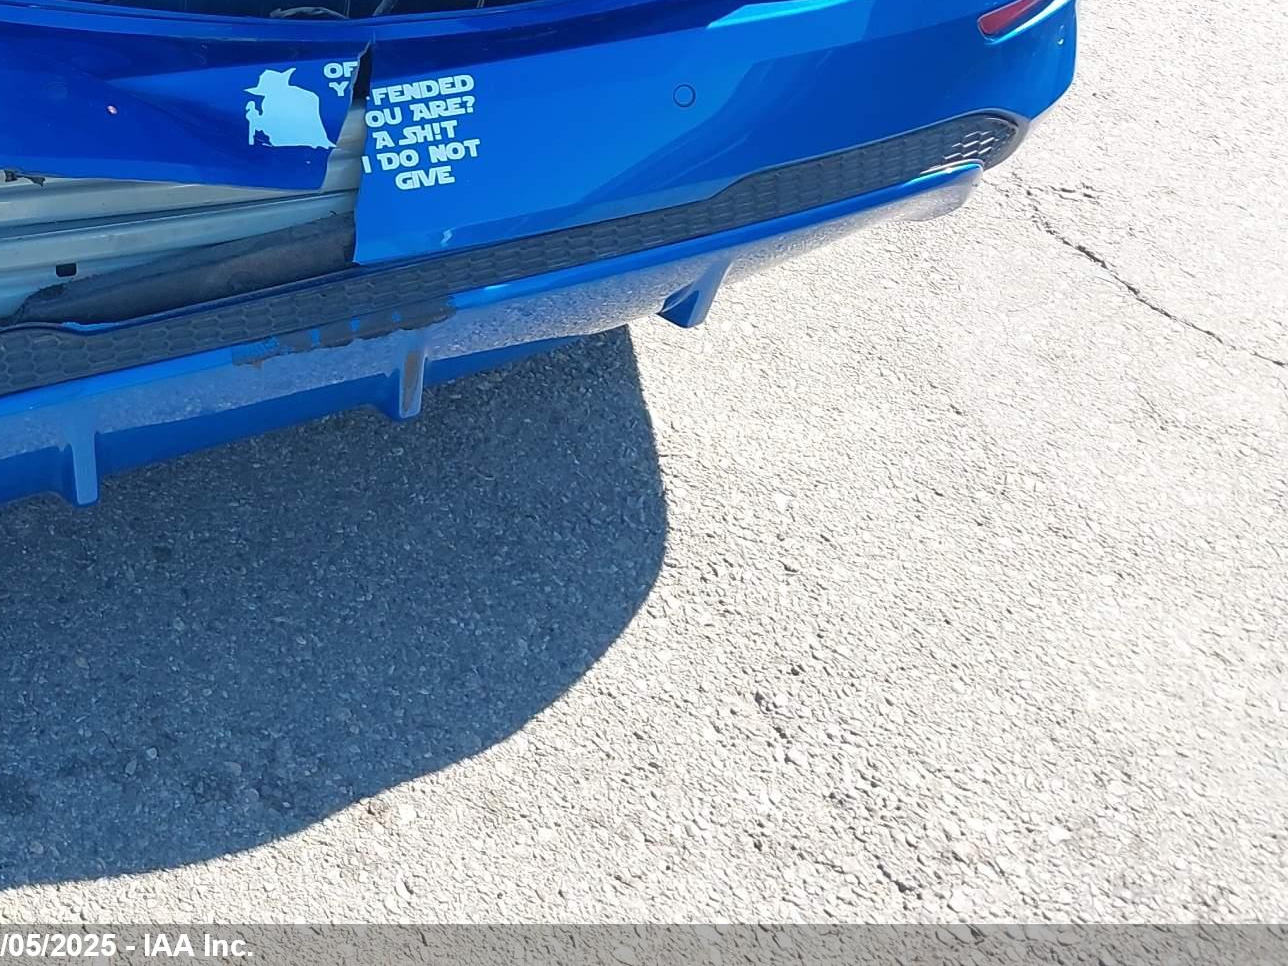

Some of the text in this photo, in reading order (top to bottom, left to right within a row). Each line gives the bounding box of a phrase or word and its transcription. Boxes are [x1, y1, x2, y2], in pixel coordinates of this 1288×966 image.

[372, 74, 475, 106] FENDED
[409, 95, 476, 122] ARE?
[372, 119, 458, 150] A SH!T
[361, 138, 481, 174] I DO NOT
[395, 165, 455, 190] GIVE
